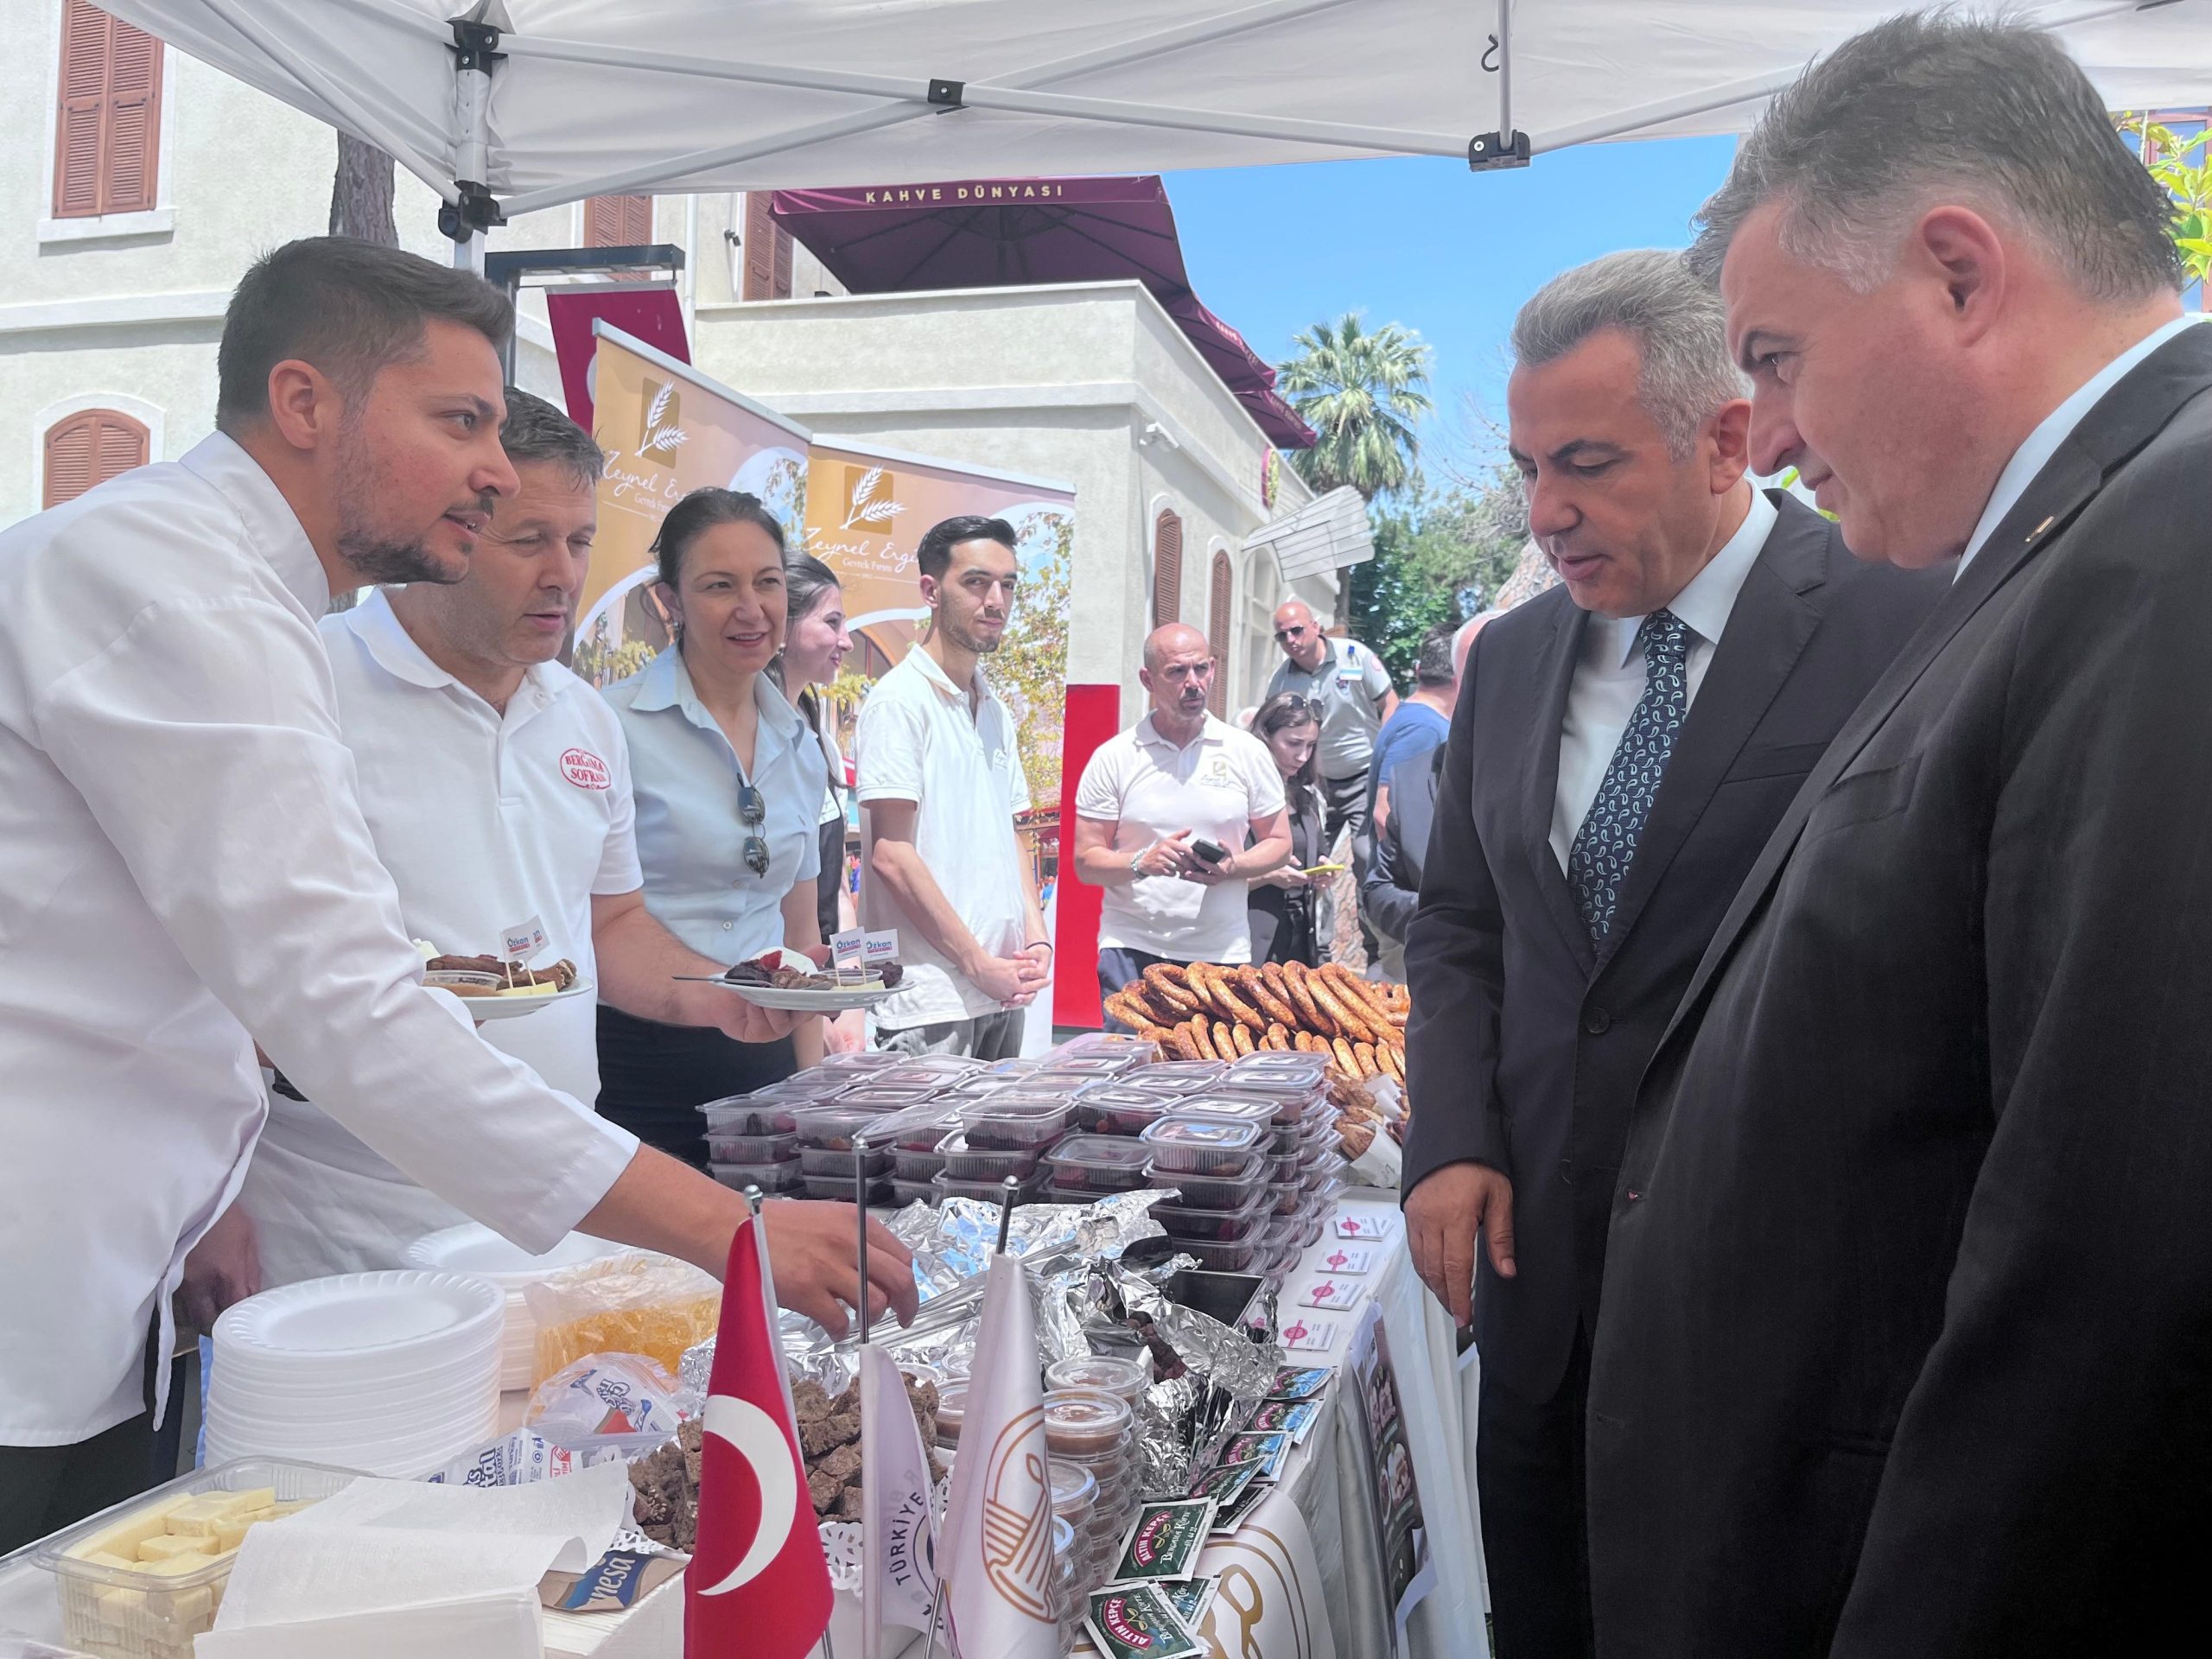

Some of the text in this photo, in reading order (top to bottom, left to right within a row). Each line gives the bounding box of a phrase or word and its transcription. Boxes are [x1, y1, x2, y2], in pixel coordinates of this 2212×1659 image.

[866, 185, 1062, 203] KAHVE DÜNYASI
[603, 450, 658, 498] Zeynel
[800, 527, 870, 564] Zeynel
[565, 754, 604, 772] BERGAMA
[836, 938, 861, 950] Özkan
[866, 940, 893, 950] Özkan
[890, 1491, 927, 1586] TÜRKİYE
[1108, 1599, 1122, 1624] KEPÇE
[1114, 1624, 1150, 1646] ALTIN
